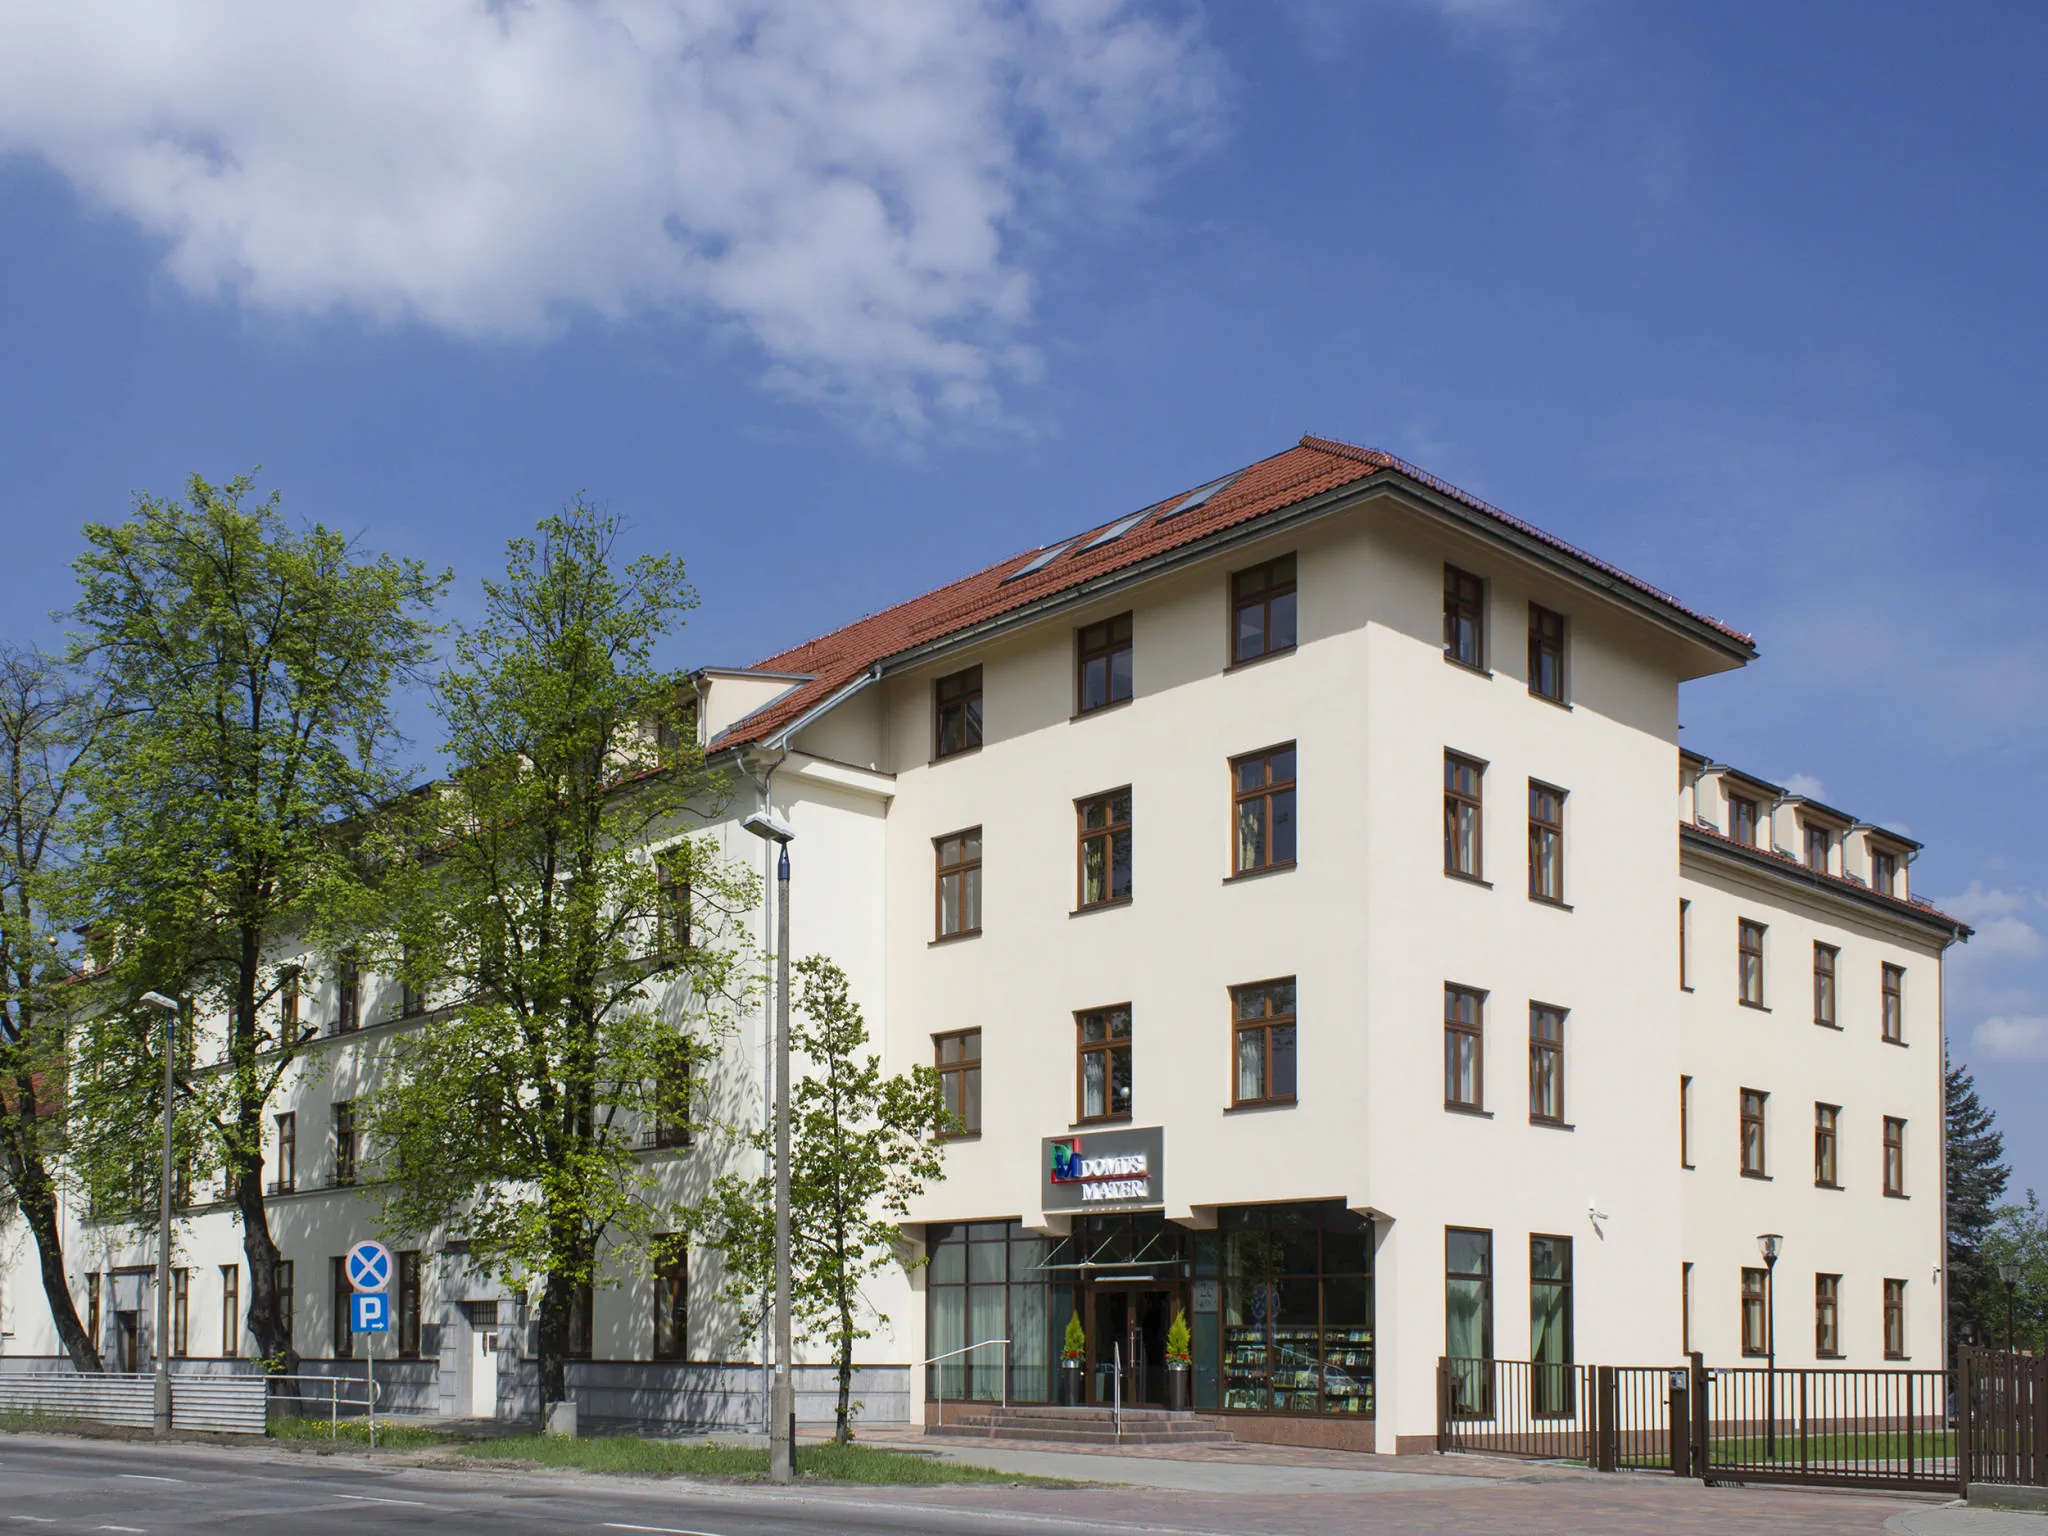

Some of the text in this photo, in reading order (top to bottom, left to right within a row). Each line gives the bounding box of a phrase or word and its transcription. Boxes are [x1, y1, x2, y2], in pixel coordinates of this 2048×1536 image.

[1081, 1155, 1147, 1177] DOMUS
[1081, 1180, 1149, 1200] MATER
[360, 1297, 381, 1328] P
